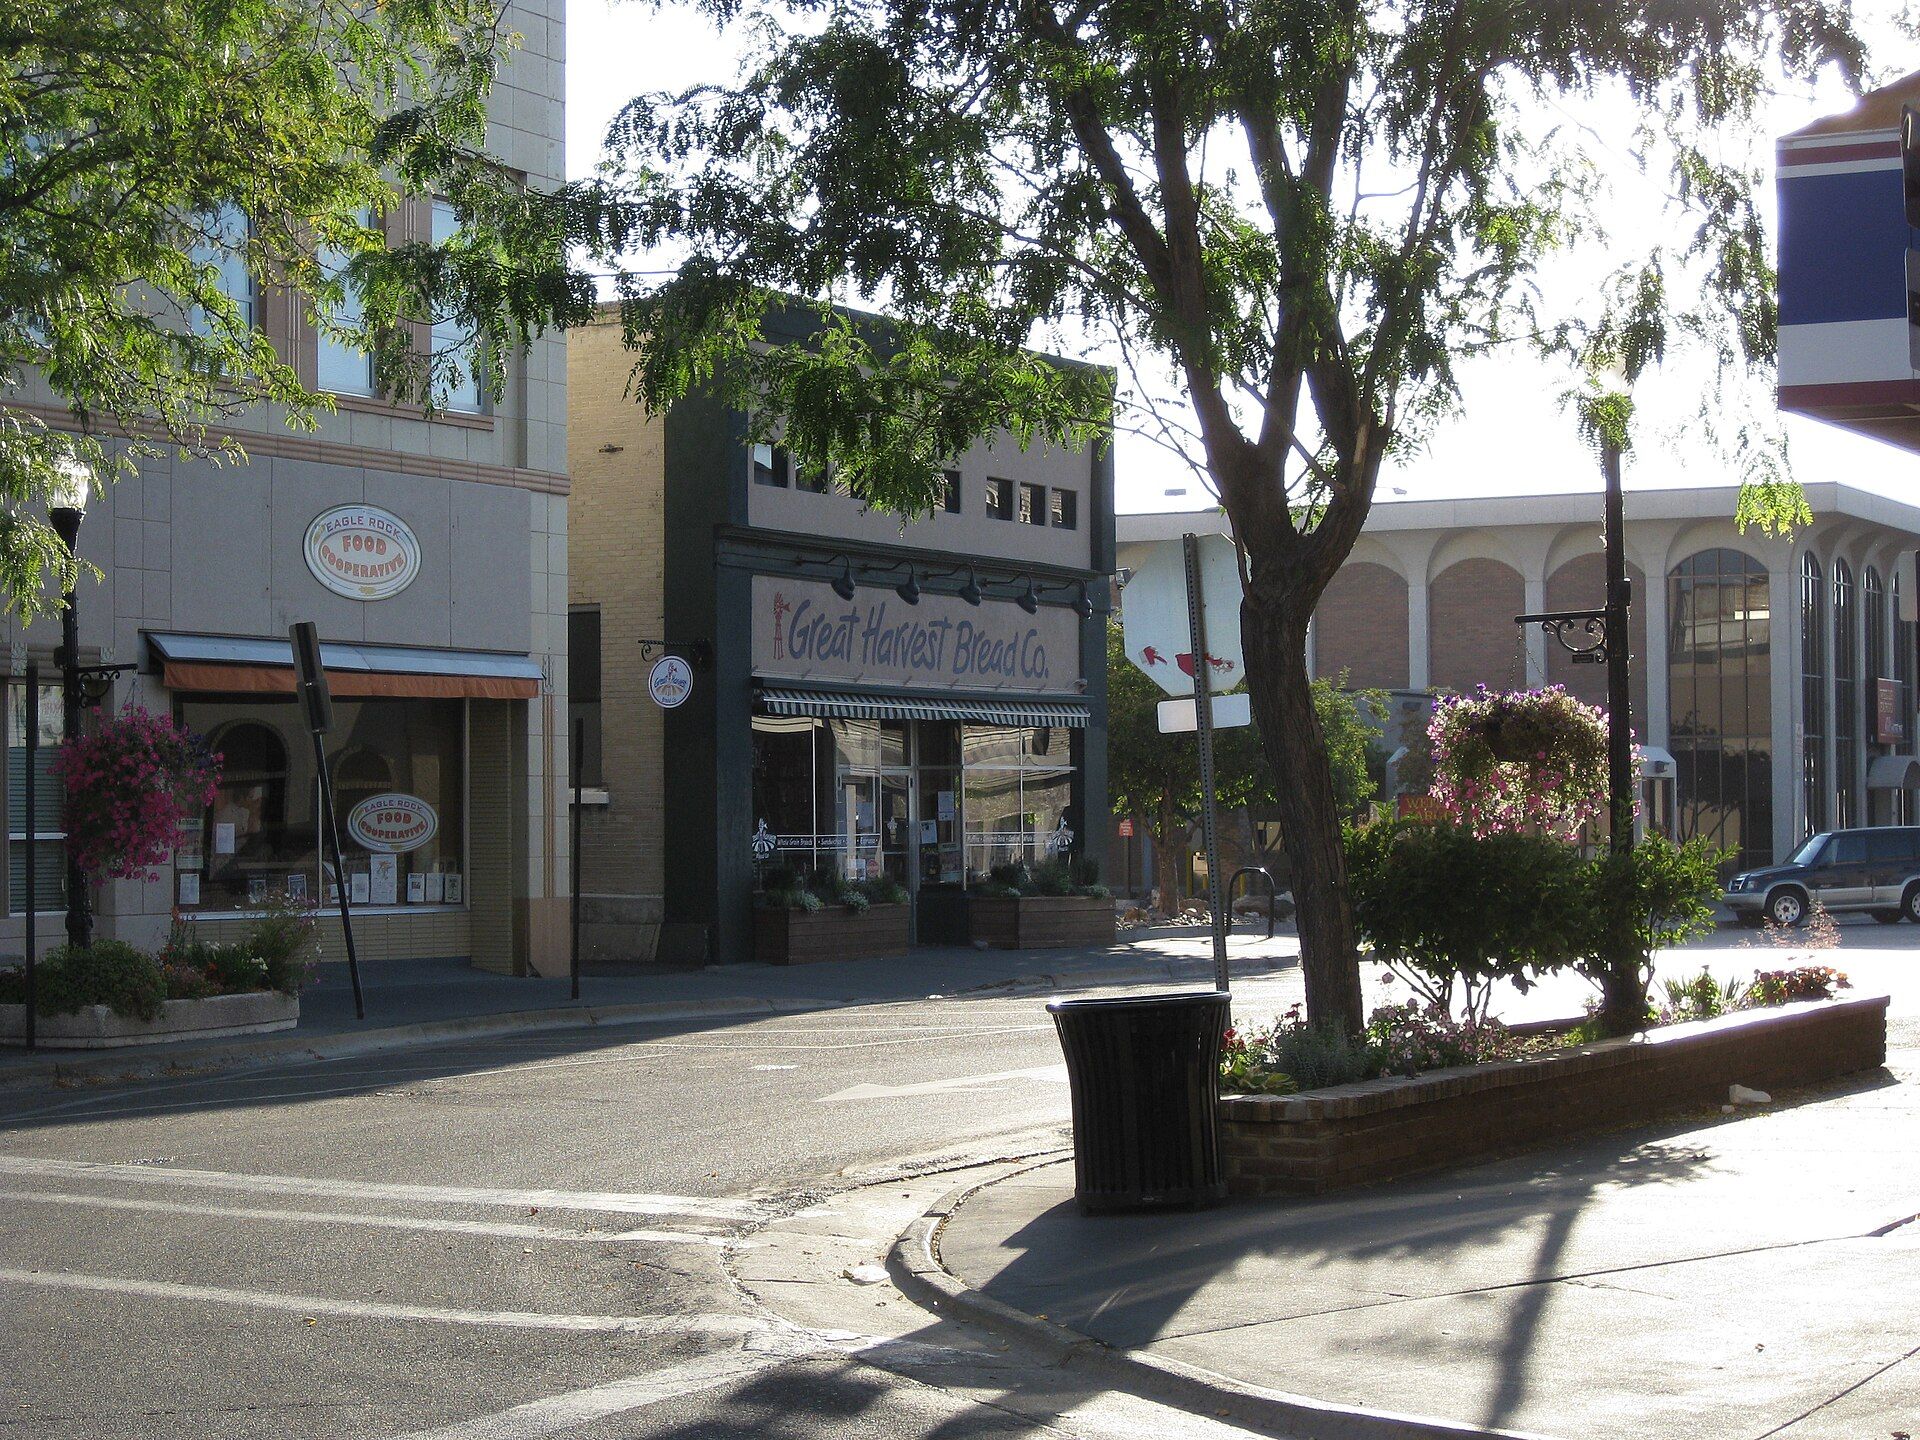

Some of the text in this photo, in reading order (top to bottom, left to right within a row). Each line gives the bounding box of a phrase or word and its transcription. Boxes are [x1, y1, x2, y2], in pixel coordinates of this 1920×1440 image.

[325, 516, 401, 540] EAGLE ROCK
[342, 534, 387, 556] FOOD
[321, 544, 405, 578] COOPERATIVE
[788, 599, 1050, 679] Great Harvest Bread Co.
[363, 799, 422, 813] EAGLE ROCK
[376, 812, 412, 824] FOOD
[360, 820, 426, 839] COOPERATIVE
